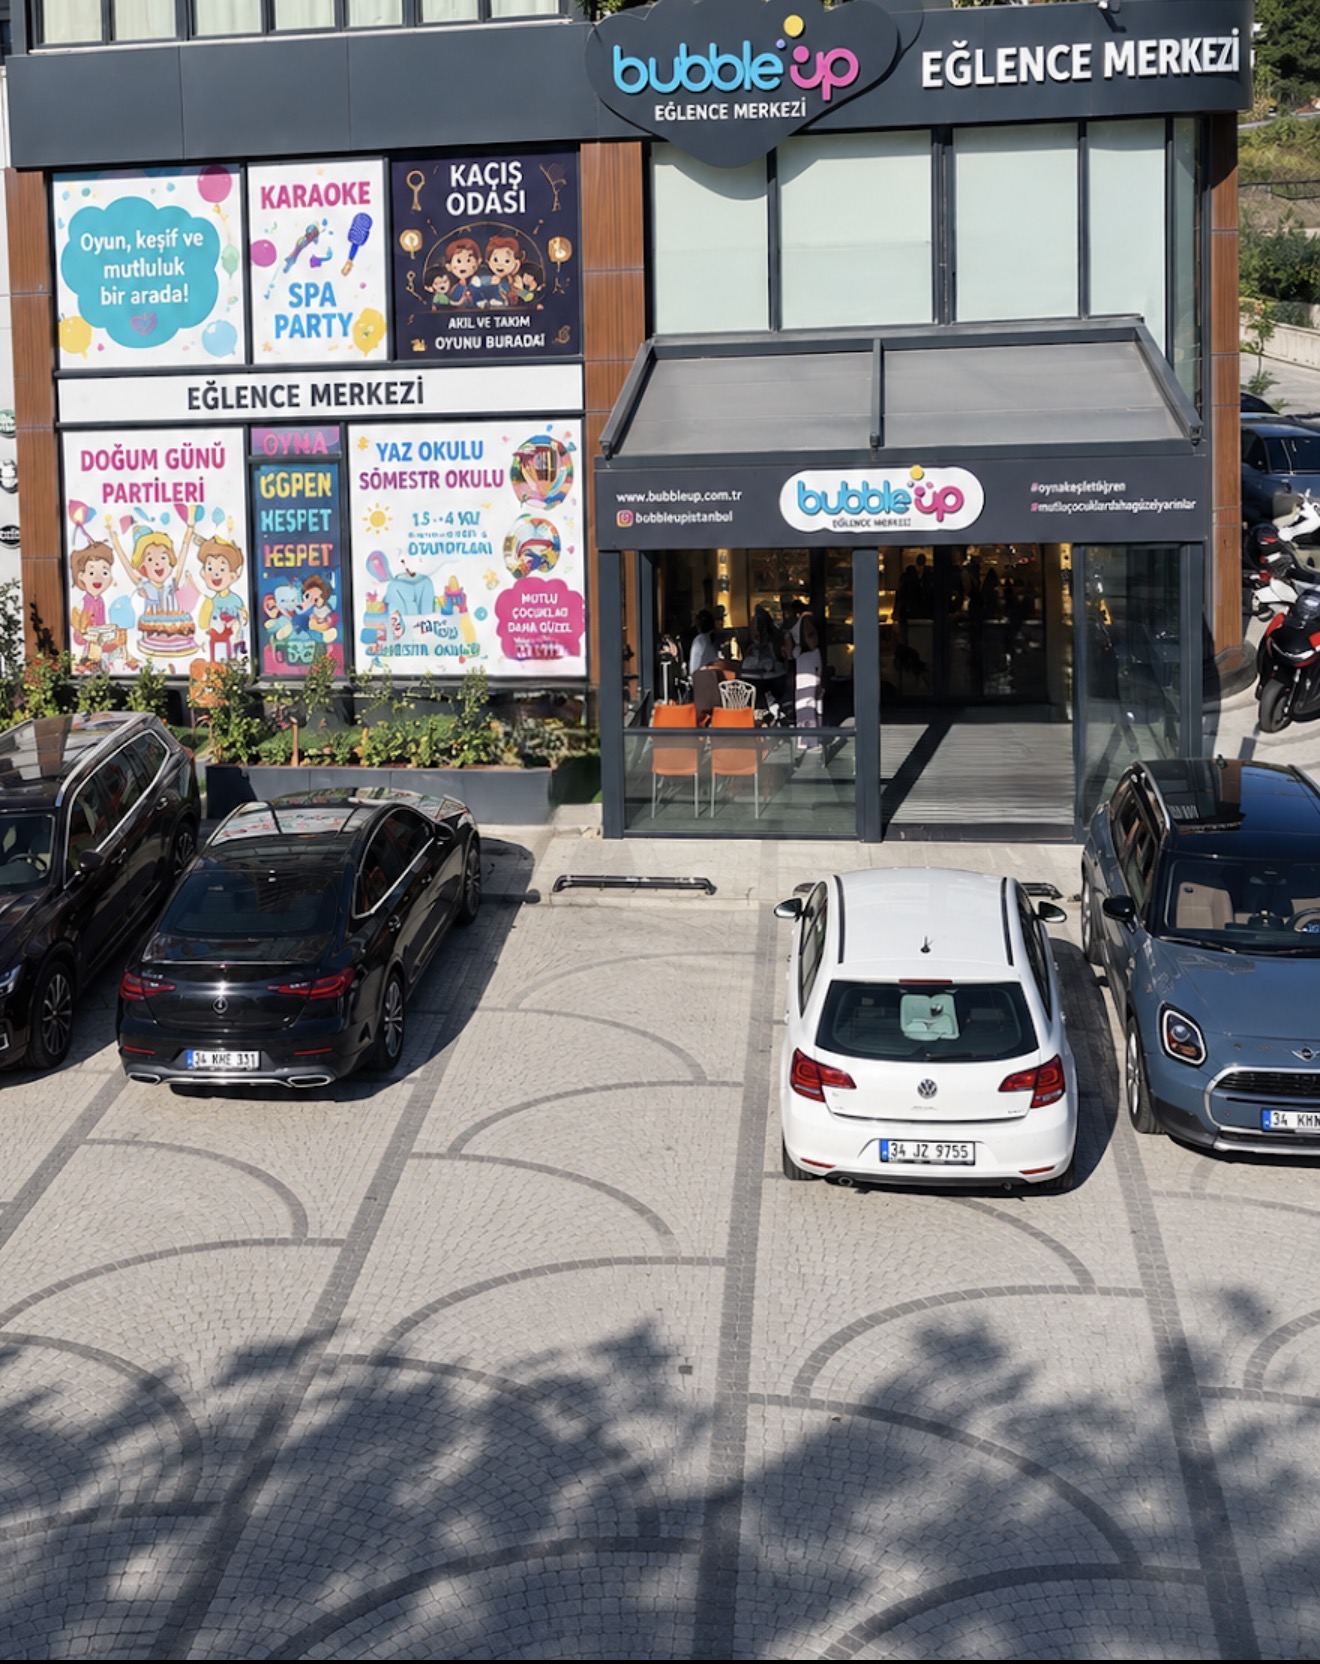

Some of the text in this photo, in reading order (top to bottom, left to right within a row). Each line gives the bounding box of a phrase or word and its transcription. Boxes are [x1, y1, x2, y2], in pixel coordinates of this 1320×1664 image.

[613, 40, 784, 94] bubble
[922, 28, 1239, 88] EĞLENCE MERKEZİ
[654, 97, 807, 121] EĞLENCE MERKEZİ
[450, 161, 523, 191] KAÇIŞ
[261, 181, 371, 209] KARAOKE
[446, 190, 526, 216] ODASI
[80, 229, 204, 255] Oyun, keşif ve
[104, 257, 185, 278] mutluluk
[100, 284, 189, 305] bir arada!
[288, 281, 337, 308] SPA
[275, 312, 353, 339] PARTY
[477, 316, 491, 328] VE
[435, 336, 482, 350] OYUNU
[187, 375, 424, 410] EĞLENCE MERKEZİ
[80, 441, 226, 472] DOĞUM GÜNÜ
[262, 432, 328, 456] OYNA
[376, 440, 484, 462] YAZ OKULU
[102, 477, 204, 504] PARTİLERİ
[359, 467, 504, 490] SÖMESTR OKULU
[616, 490, 742, 503] www.bubbleup.com.tr
[797, 479, 912, 515] bubble
[1273, 1112, 1288, 1126] 34
[891, 1142, 969, 1158] 34 JZ 9755
